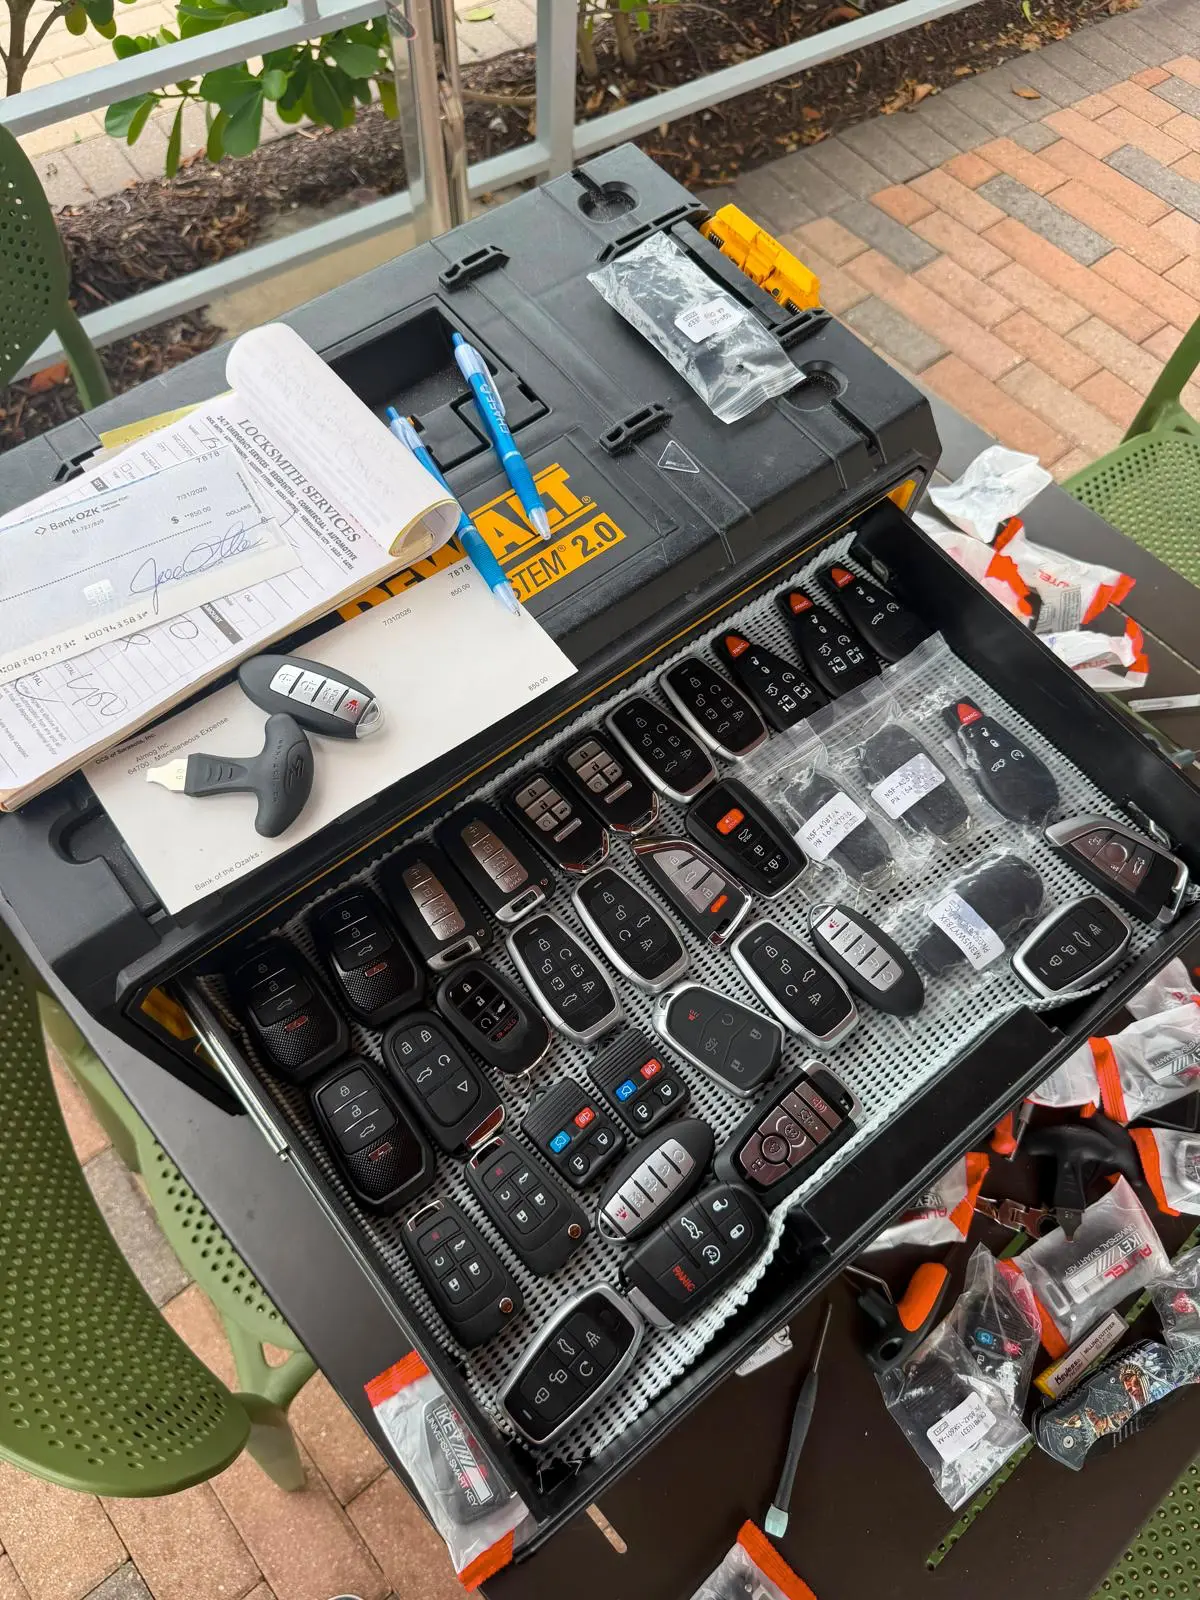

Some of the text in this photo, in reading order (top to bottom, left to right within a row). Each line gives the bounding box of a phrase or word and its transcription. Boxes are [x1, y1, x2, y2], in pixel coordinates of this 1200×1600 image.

[226, 425, 251, 450] EMERGENCY
[248, 448, 269, 469] SERVICES
[268, 470, 297, 497] RESIDENTIAL
[297, 499, 326, 528] COMMERCIAL
[327, 530, 357, 561] AUTOMOTIVE
[237, 418, 361, 543] LOCKSMITH SERVICES
[571, 520, 618, 558] 2.0
[382, 608, 412, 627] 7/31/2026
[153, 732, 201, 762] Miscellaneous
[199, 716, 230, 736] Expense
[193, 851, 260, 891] Bank of the Ozarks
[1062, 1221, 1136, 1276] UNIVERSAL SMART KEY
[1102, 1243, 1154, 1283] AUTEL
[1113, 1231, 1143, 1258] IKEY
[672, 1264, 696, 1292] PANIC
[434, 1407, 461, 1441] IKEY
[424, 1413, 454, 1460] UNIVERSAL
[447, 1458, 469, 1489] SMART
[463, 1488, 478, 1507] KEY
